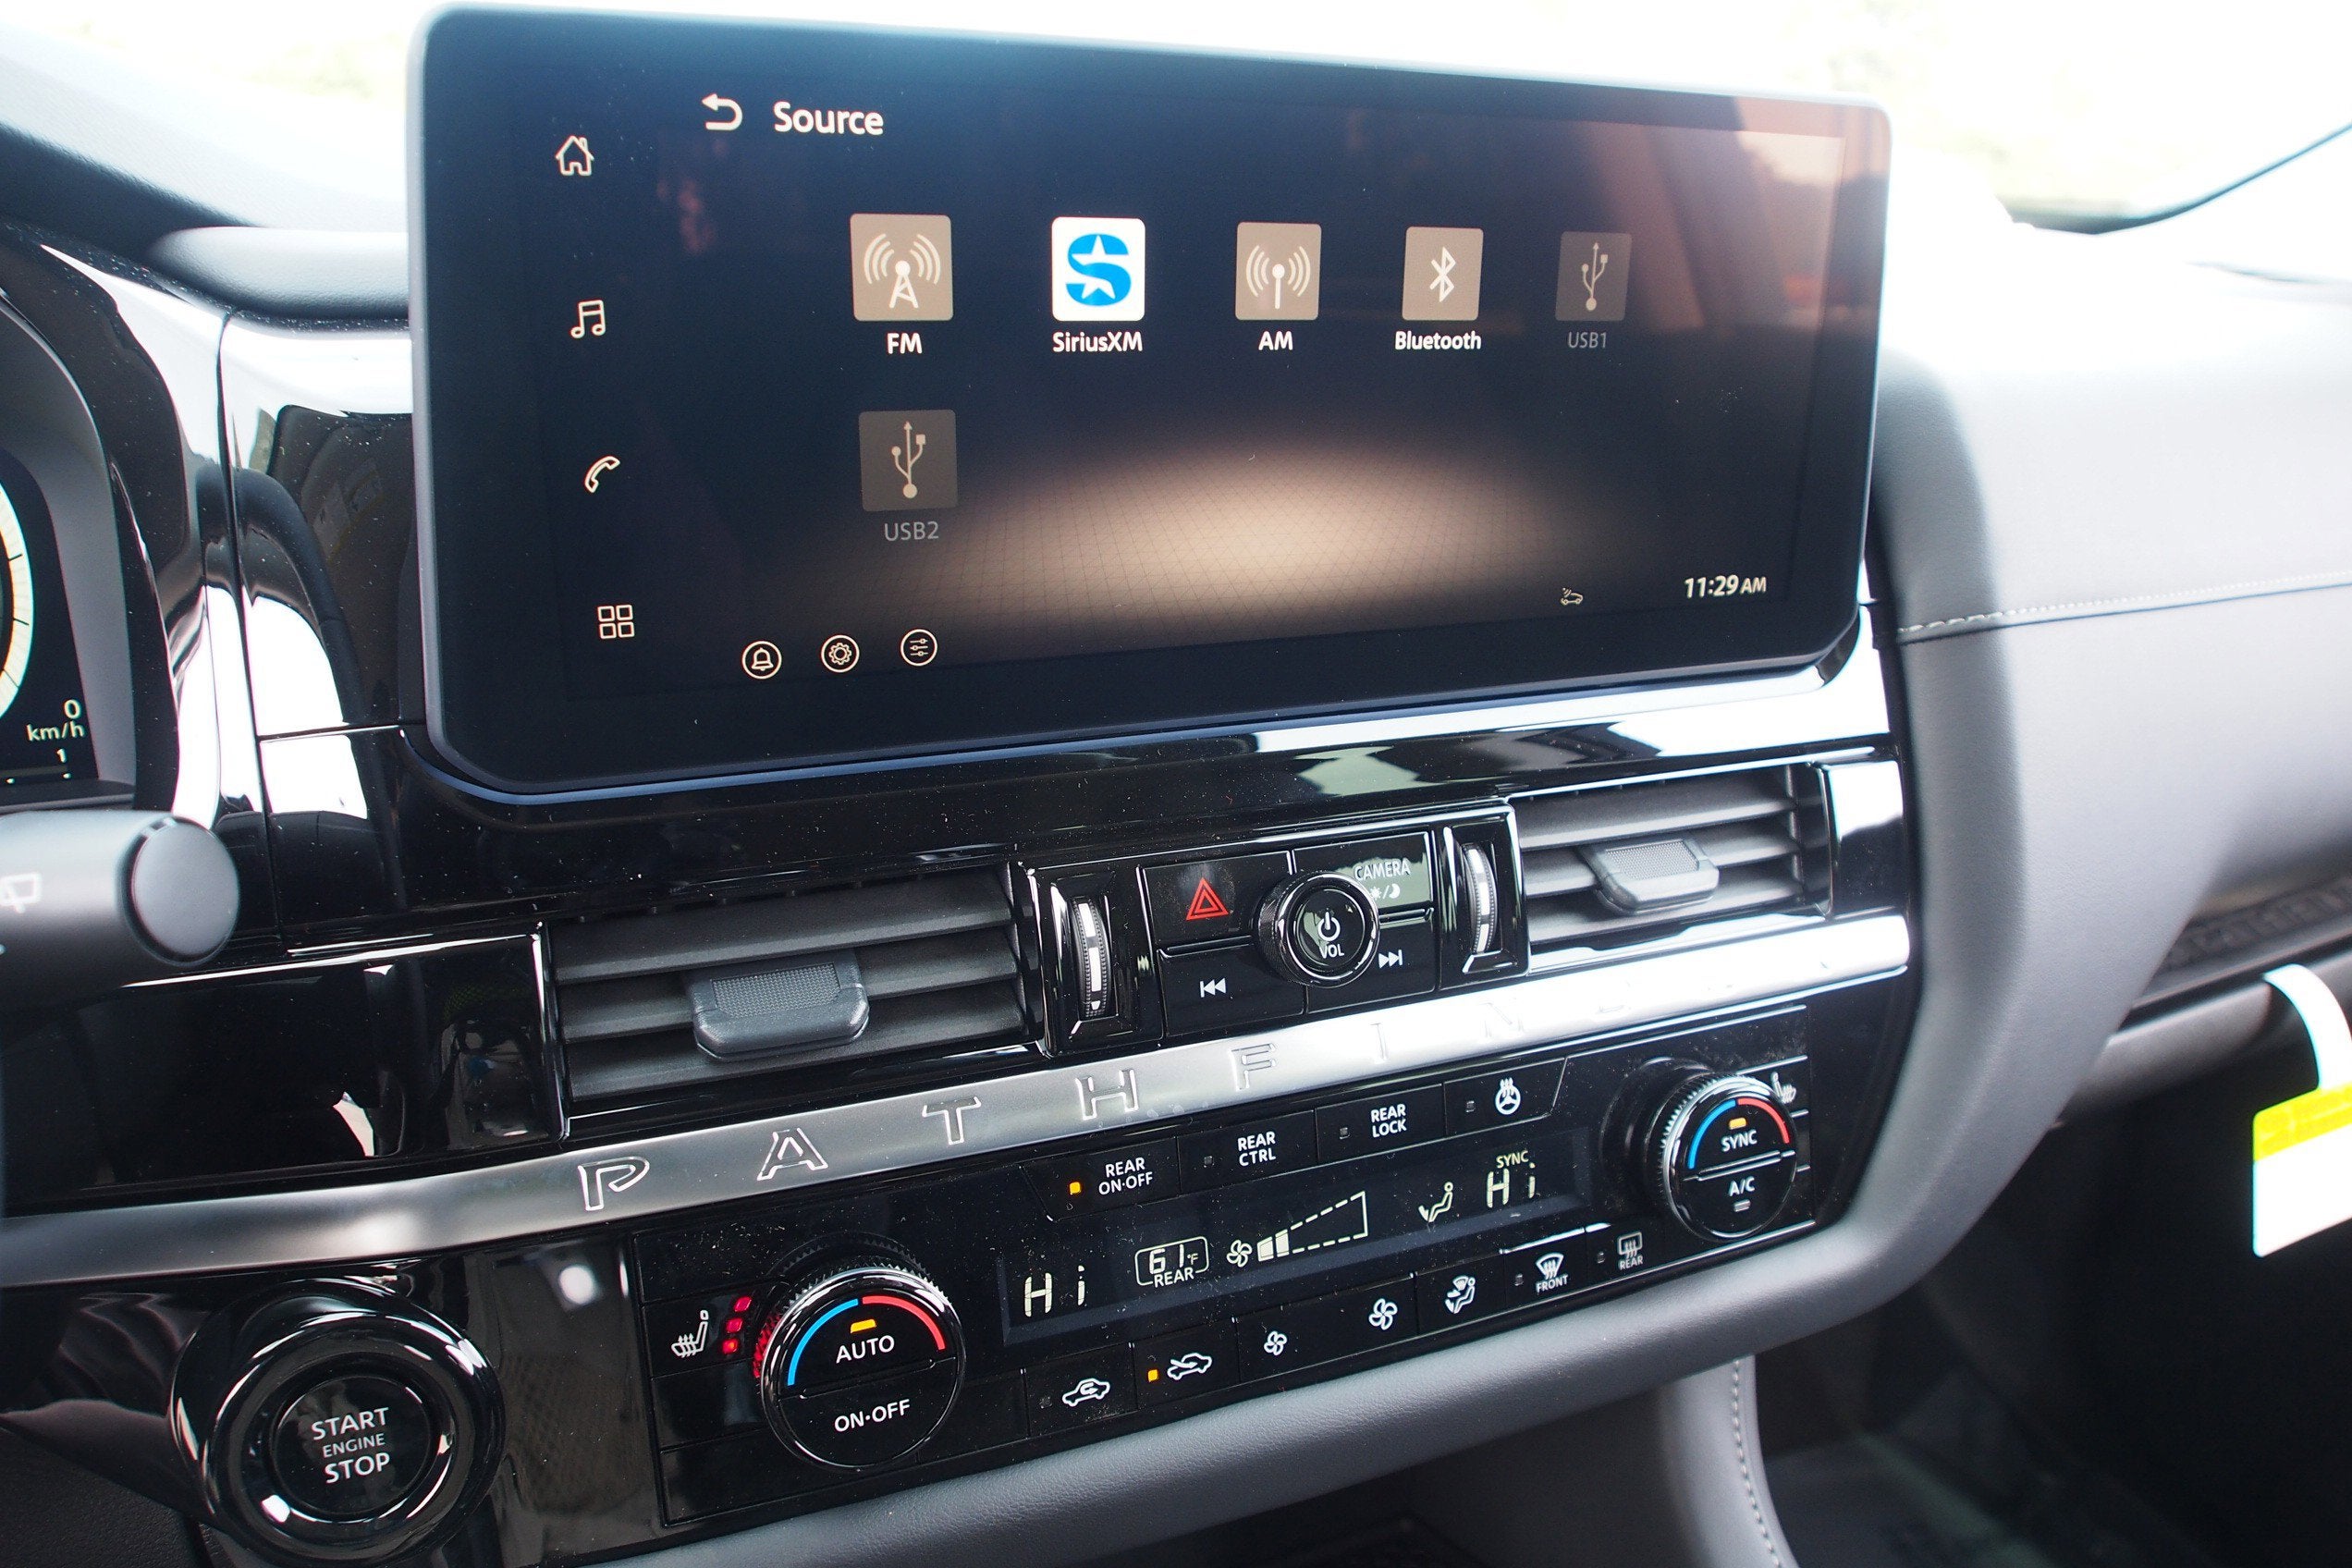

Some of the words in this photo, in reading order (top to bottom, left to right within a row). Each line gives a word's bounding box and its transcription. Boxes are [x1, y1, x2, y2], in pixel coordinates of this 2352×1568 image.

[773, 101, 884, 136] Source
[887, 332, 923, 355] FM
[1051, 330, 1144, 352] SiriusXM
[1258, 330, 1293, 351] AM
[1394, 330, 1482, 350] Bluetooth
[1567, 330, 1608, 349] USB1
[884, 521, 939, 543] USB2
[1684, 574, 1739, 598] 11:29
[1740, 575, 1768, 594] AM
[64, 699, 81, 719] 0
[26, 721, 85, 741] km/h
[56, 748, 67, 764] 1
[1354, 858, 1411, 881] CAMERA
[1318, 943, 1345, 960] VOL
[1369, 1103, 1407, 1123] REAR
[1370, 1117, 1408, 1139] LOCK
[1237, 1131, 1277, 1152] REAR
[1721, 1130, 1758, 1152] SYNC
[1238, 1145, 1277, 1167] CTRL
[1496, 1150, 1530, 1170] SYNC
[1105, 1157, 1146, 1178] REAR
[1728, 1175, 1757, 1197] A/C
[1619, 1256, 1645, 1271] REAR
[1153, 1267, 1195, 1288] REAR
[1536, 1274, 1569, 1292] FRONT
[836, 1334, 895, 1365] AUTO
[311, 1407, 388, 1441] START
[323, 1434, 386, 1459] ENGINE
[325, 1452, 391, 1484] STOP
